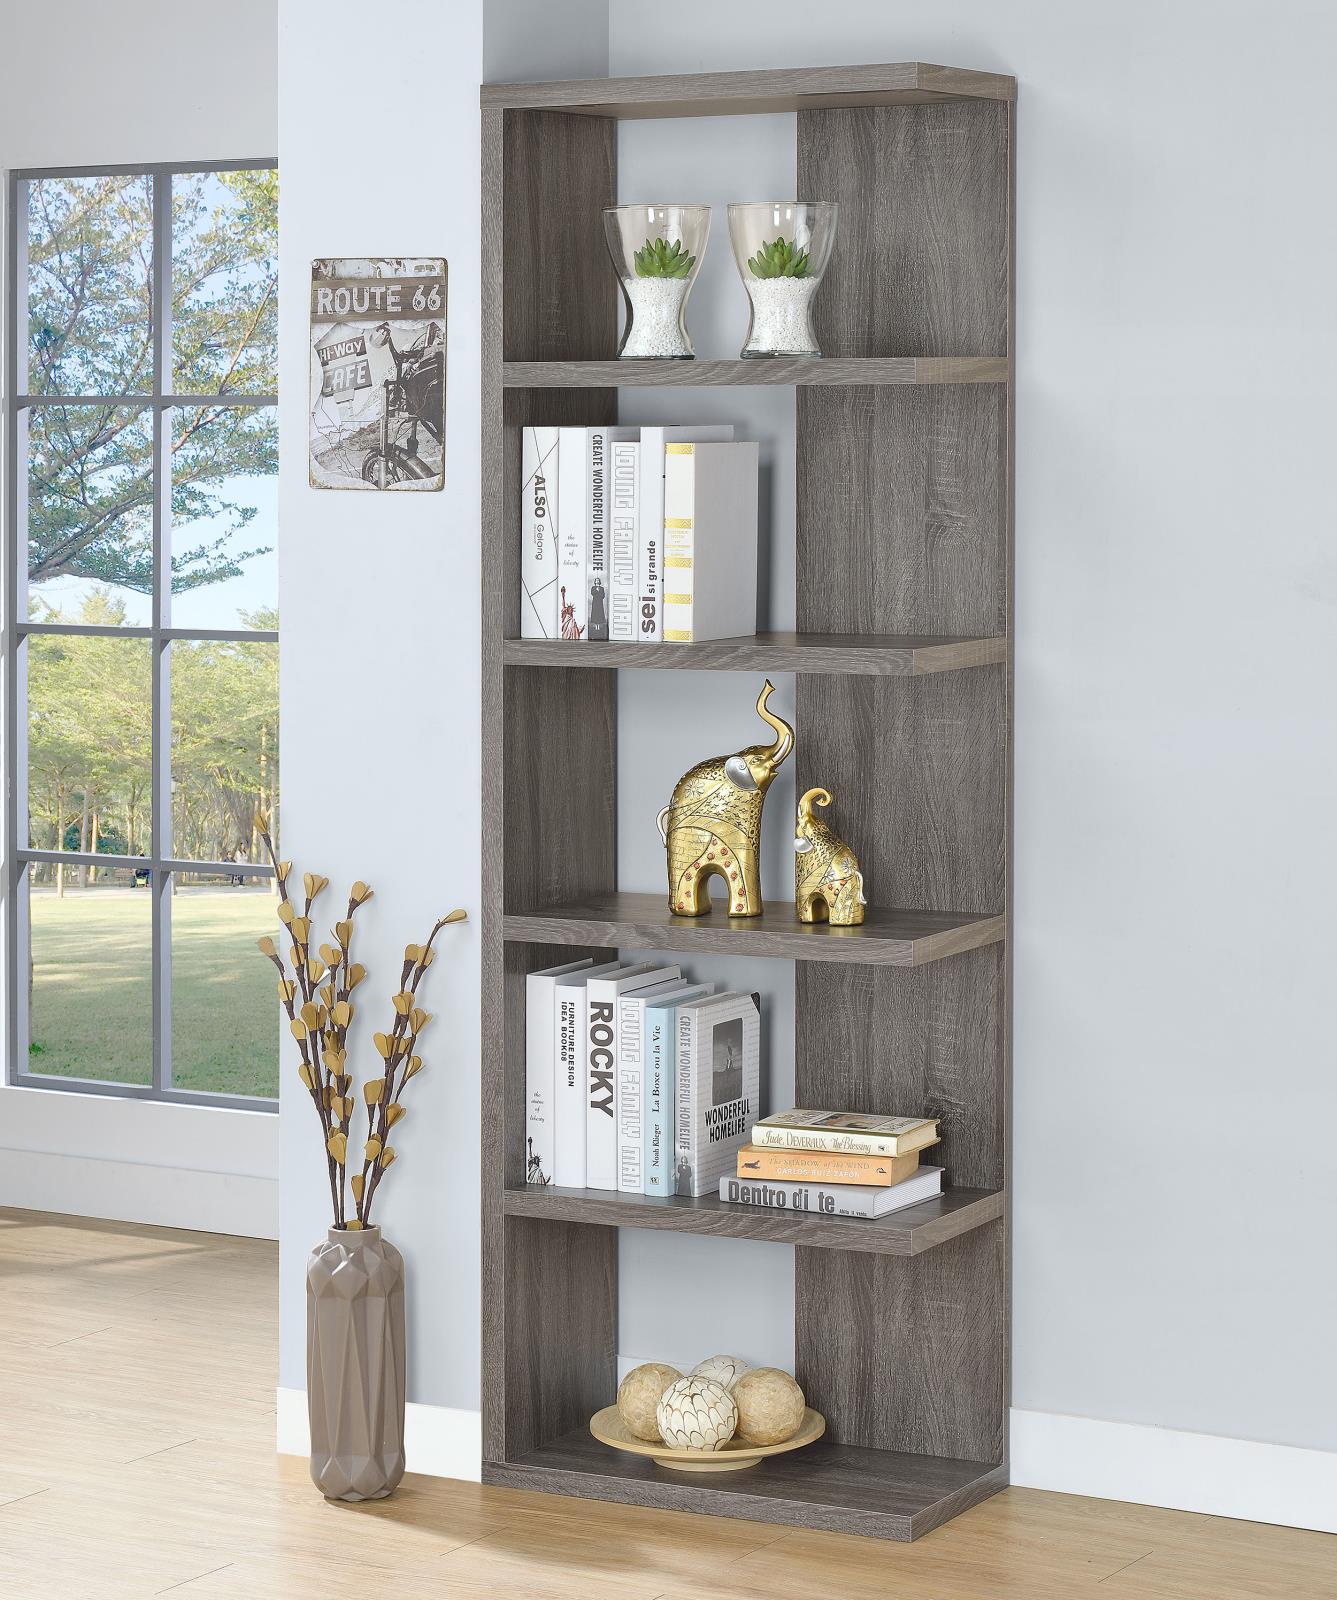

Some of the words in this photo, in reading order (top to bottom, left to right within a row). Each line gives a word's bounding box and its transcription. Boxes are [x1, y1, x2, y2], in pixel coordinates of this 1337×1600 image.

[316, 285, 402, 315] ROUTE
[411, 284, 441, 312] 66
[319, 338, 364, 362] Hi-Way
[323, 364, 367, 393] CAFE
[592, 434, 603, 466] CREATE
[614, 445, 635, 508] LOVING
[534, 475, 546, 518] ALSO
[592, 469, 603, 524] WONDERFUL
[535, 524, 545, 561] Gelang
[592, 527, 603, 571] HOMELIFE
[613, 517, 634, 585] FAMILY
[646, 540, 657, 581] grande
[646, 584, 655, 593] si
[613, 594, 633, 636] MAN
[620, 1000, 641, 1063] LOVING
[652, 1025, 661, 1041] Vie
[679, 1016, 691, 1047] CREATE
[590, 1001, 614, 1118] ROCKY
[652, 1045, 661, 1054] la
[652, 1056, 661, 1069] ou
[652, 1072, 661, 1097] Boxe
[679, 1050, 691, 1105] WONDERFUL
[620, 1069, 641, 1138] FAMILY
[652, 1100, 661, 1113] La
[704, 1098, 751, 1127] WONDERFUL
[679, 1107, 691, 1150] HOMELIFE
[709, 1117, 746, 1143] HOMELIFE
[762, 1130, 785, 1146] Jude
[786, 1131, 827, 1150] DEVERAUX
[652, 1148, 660, 1168] Noah
[831, 1137, 844, 1150] The
[843, 1136, 872, 1154] Blessing
[620, 1145, 641, 1188] MAN
[776, 1167, 808, 1176] CARLOS
[783, 1159, 821, 1167] SHADOW
[846, 1161, 870, 1170] WIND
[728, 1180, 786, 1208] Dentro
[792, 1188, 809, 1211] di
[818, 1191, 835, 1213] te
